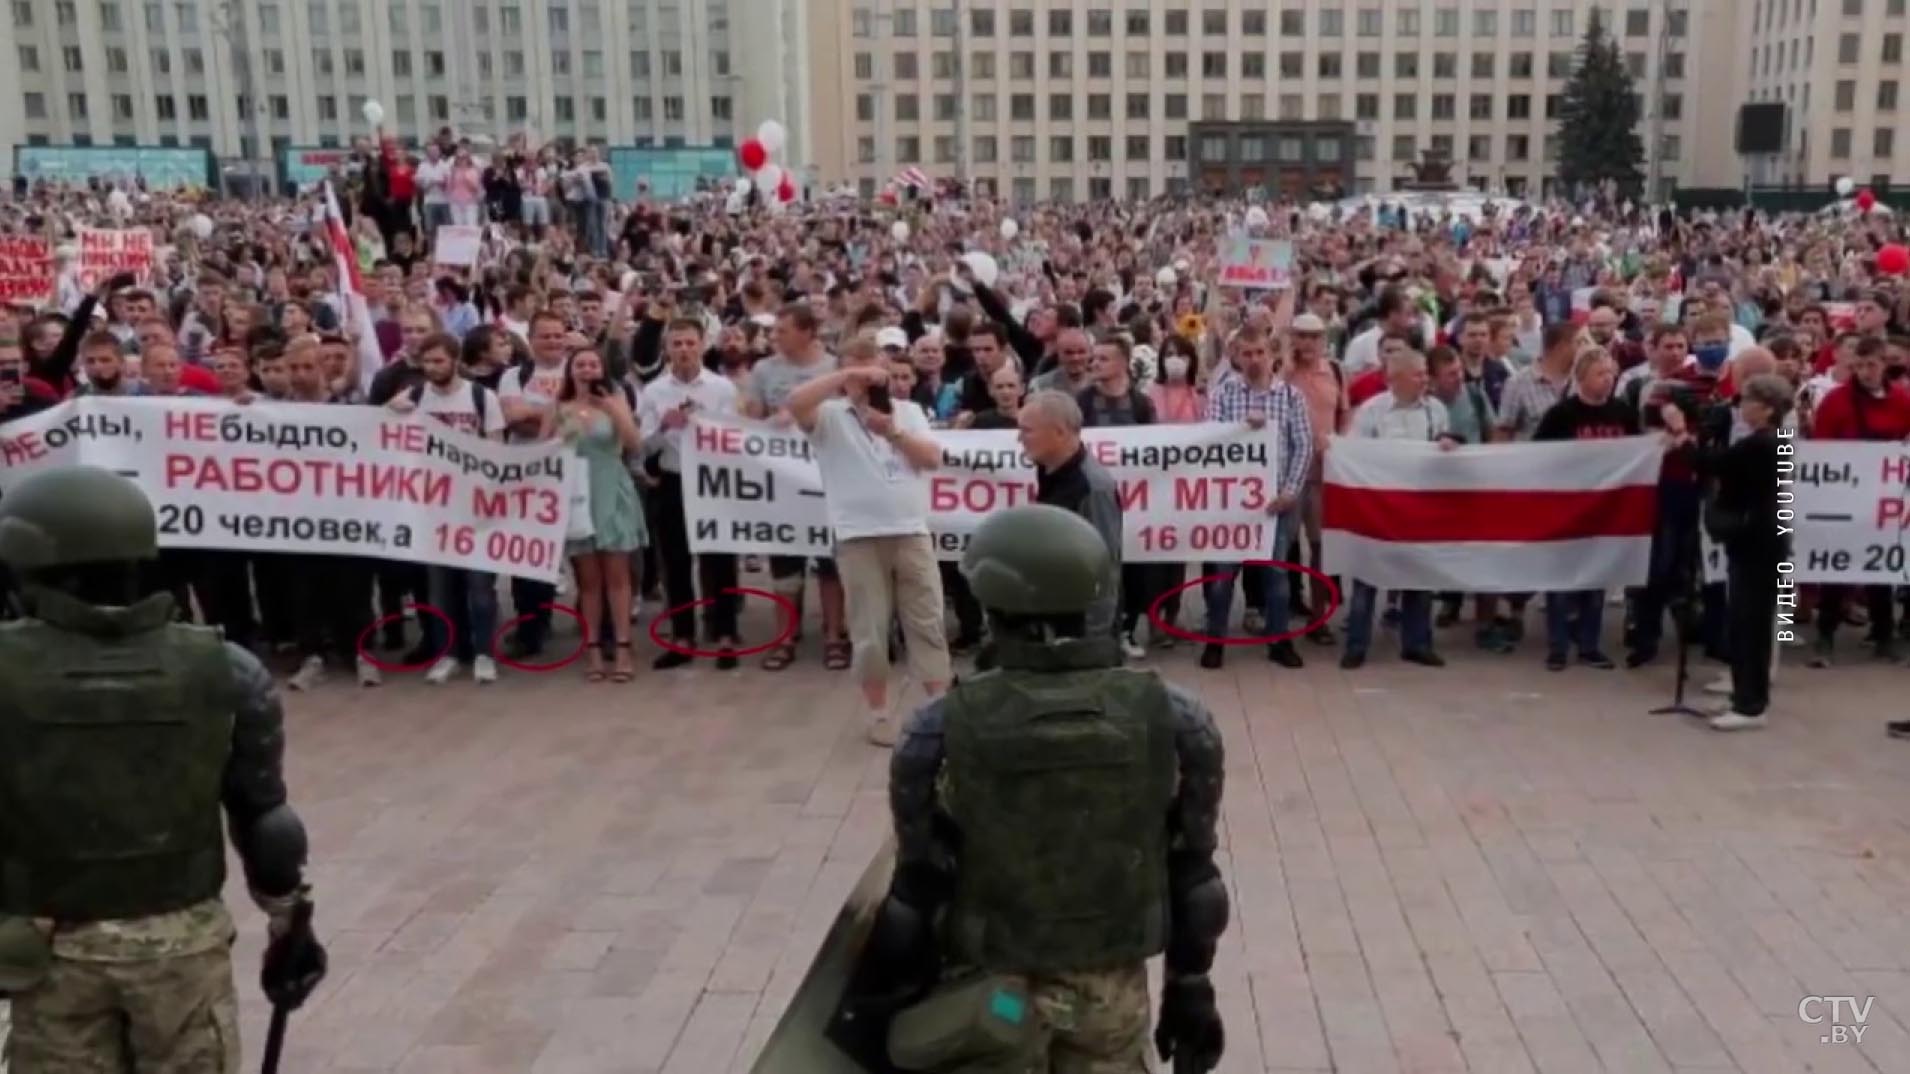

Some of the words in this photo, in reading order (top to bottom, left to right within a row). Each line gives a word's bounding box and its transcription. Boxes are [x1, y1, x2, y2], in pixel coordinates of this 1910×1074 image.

[166, 411, 358, 452] НЕбыдло,
[380, 423, 563, 483] НЕнародец
[696, 424, 811, 463] НЕовц
[1089, 441, 1267, 471] Енародец
[166, 454, 453, 507] РАБОТНИКИ
[473, 486, 560, 525] МТЗ
[697, 464, 774, 503] МЫ
[1175, 476, 1265, 511] МТЗ
[159, 503, 205, 536] 20
[436, 523, 475, 556] 16
[487, 530, 556, 570] 000!
[696, 518, 718, 541] и
[732, 520, 795, 544] нас
[1139, 525, 1177, 551] 16
[1190, 523, 1263, 551] 000!
[1808, 548, 1850, 571] не
[1863, 543, 1905, 573] 20
